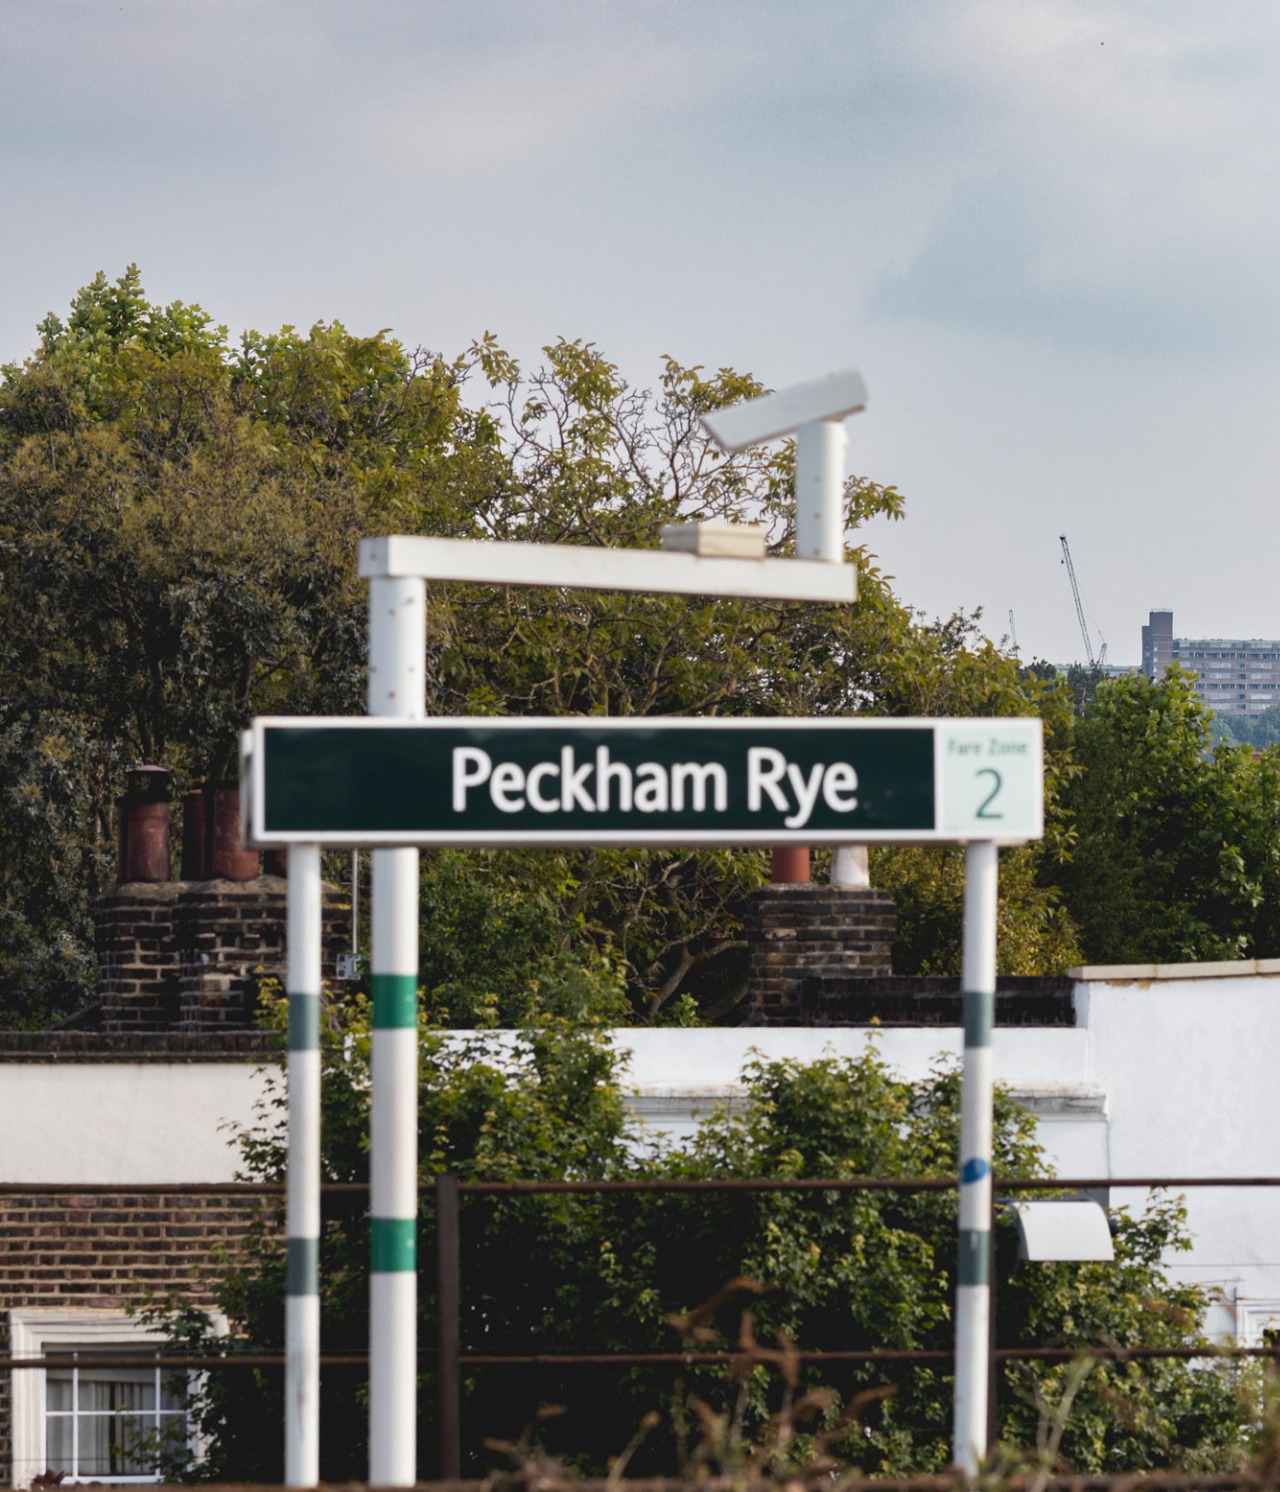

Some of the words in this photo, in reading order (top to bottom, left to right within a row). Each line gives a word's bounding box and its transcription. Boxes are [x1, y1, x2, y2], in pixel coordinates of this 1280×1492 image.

[948, 739, 981, 755] Fare
[988, 739, 1027, 755] Zone
[452, 745, 727, 812] Peckham
[747, 747, 858, 828] Rye
[975, 768, 1003, 819] 2
